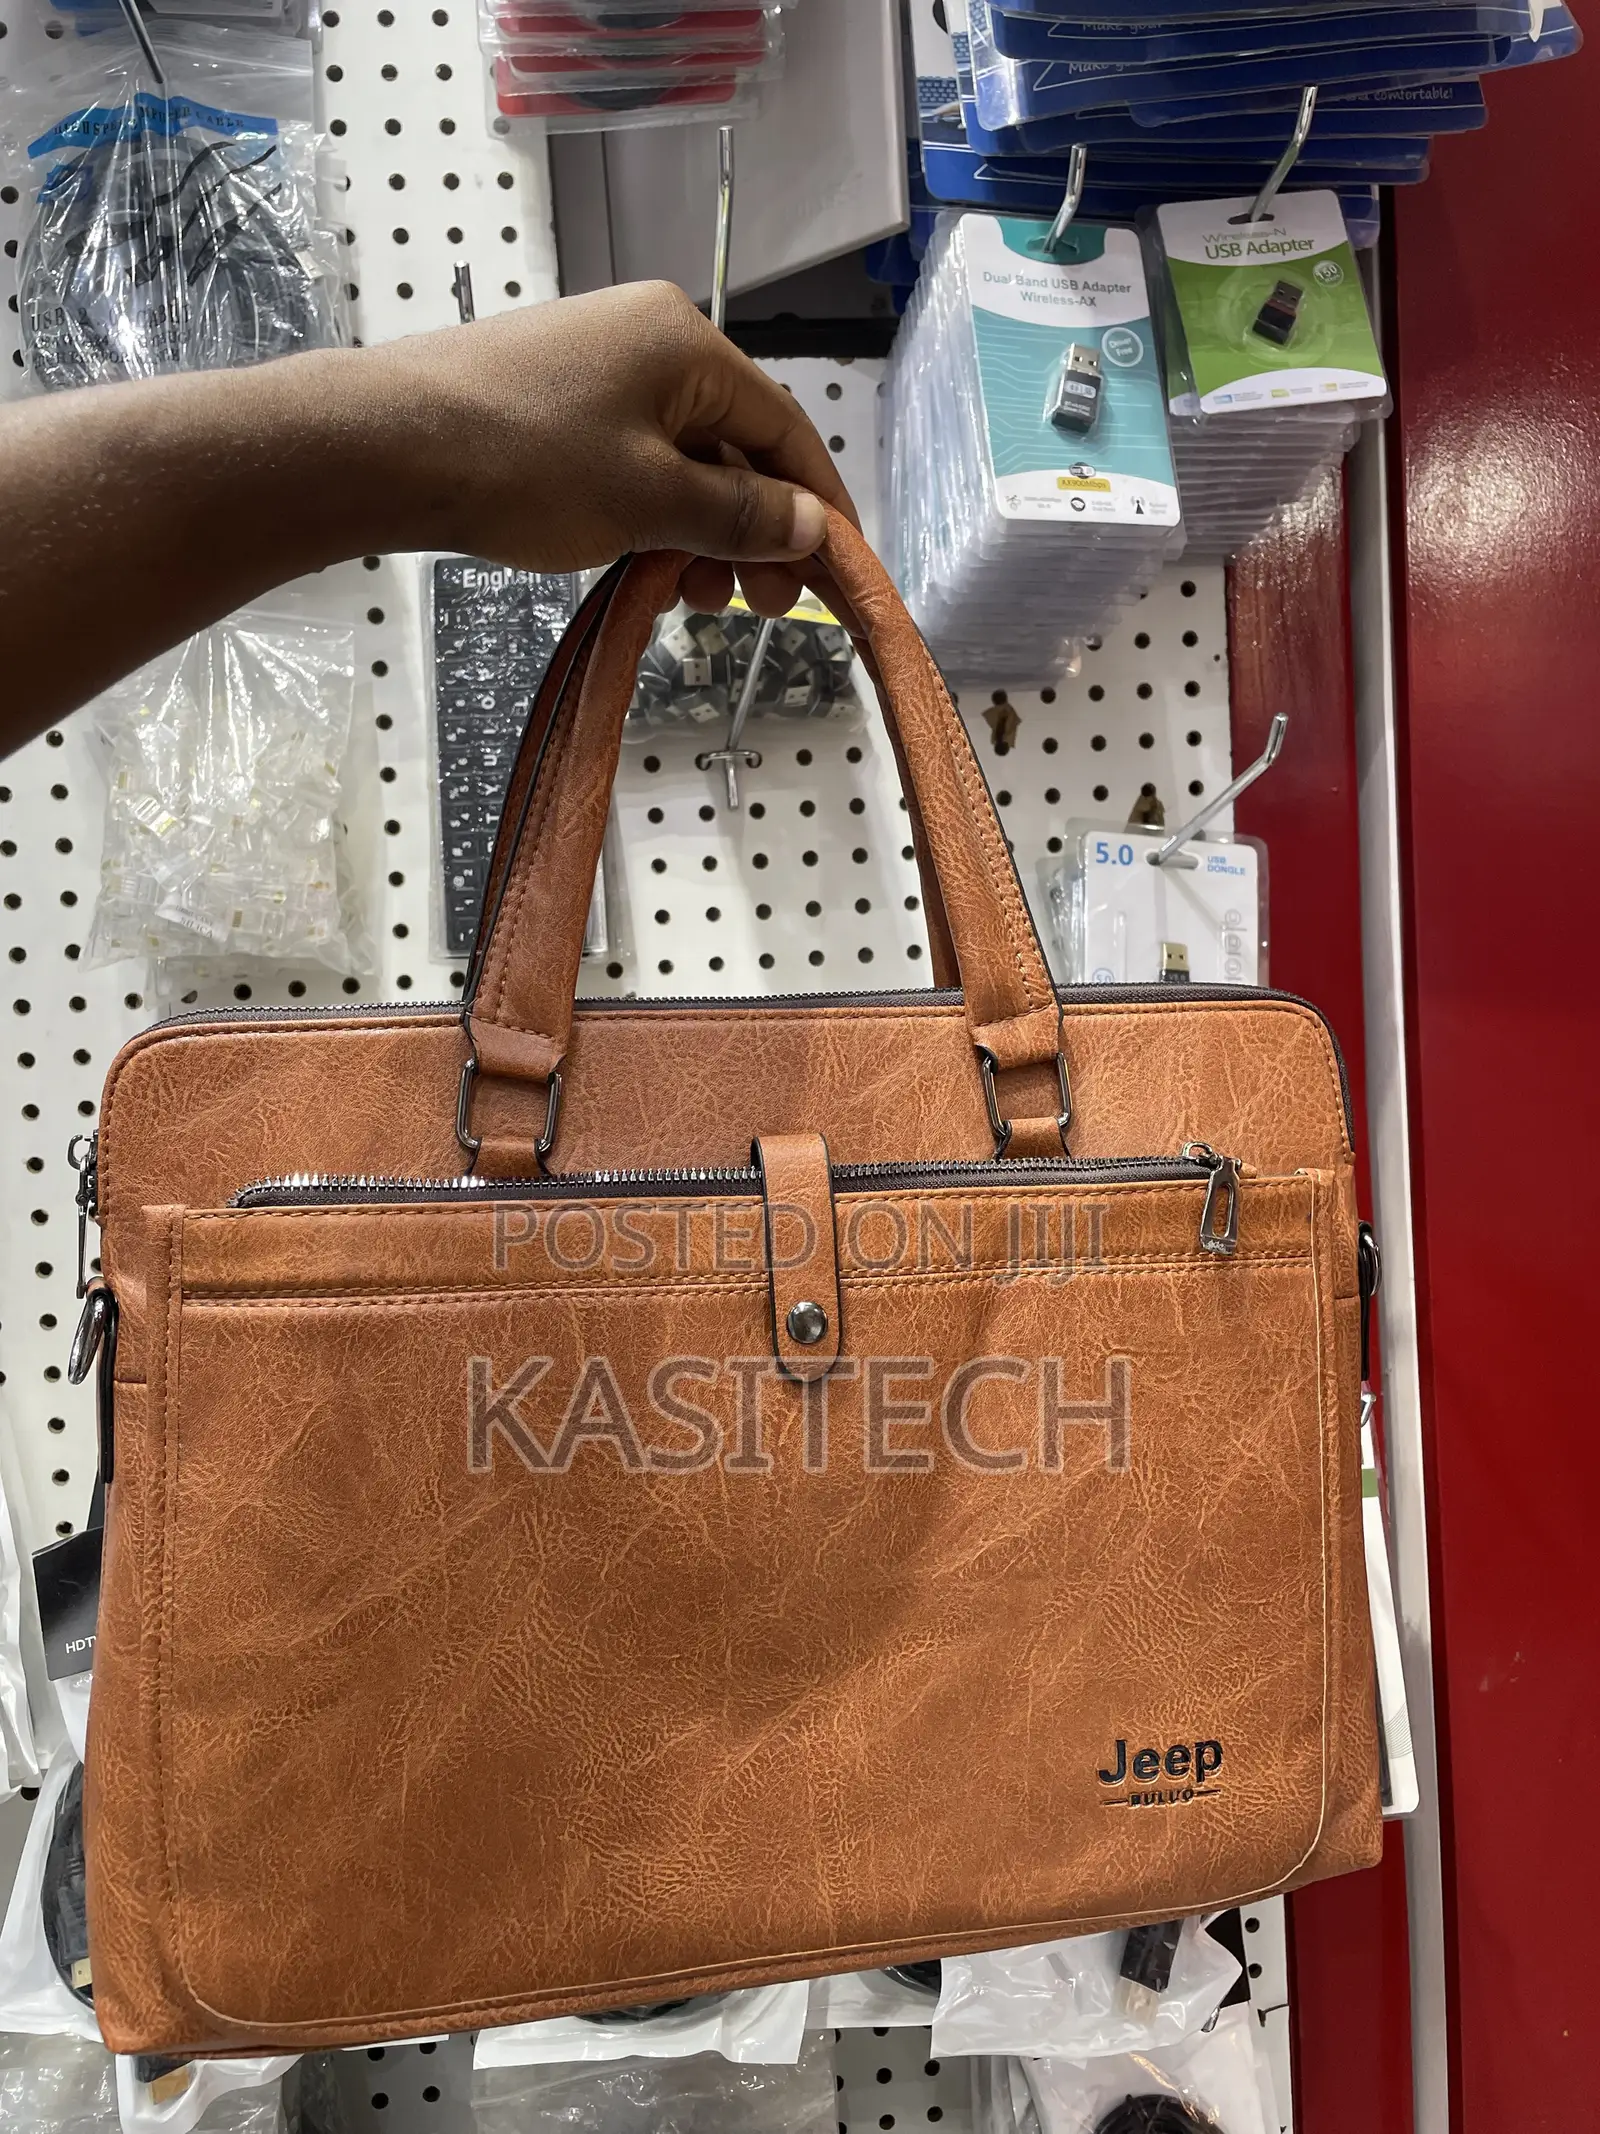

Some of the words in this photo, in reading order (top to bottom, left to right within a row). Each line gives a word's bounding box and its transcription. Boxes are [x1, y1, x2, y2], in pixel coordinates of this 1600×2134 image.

[1202, 227, 1287, 243] Wireless-N
[1205, 242, 1242, 260] USB
[1246, 239, 1315, 256] Adapter
[982, 271, 1012, 285] Dual
[1015, 274, 1048, 288] Band
[1051, 278, 1079, 291] USB
[1082, 280, 1132, 295] Adapter
[1020, 290, 1098, 307] Wireless-AX
[31, 306, 66, 332] USB
[1095, 841, 1134, 866] 5.0
[1207, 855, 1227, 864] USB
[1207, 864, 1246, 876] DONGLE
[65, 1635, 97, 1654] HDT
[1098, 1739, 1223, 1784] Jeep
